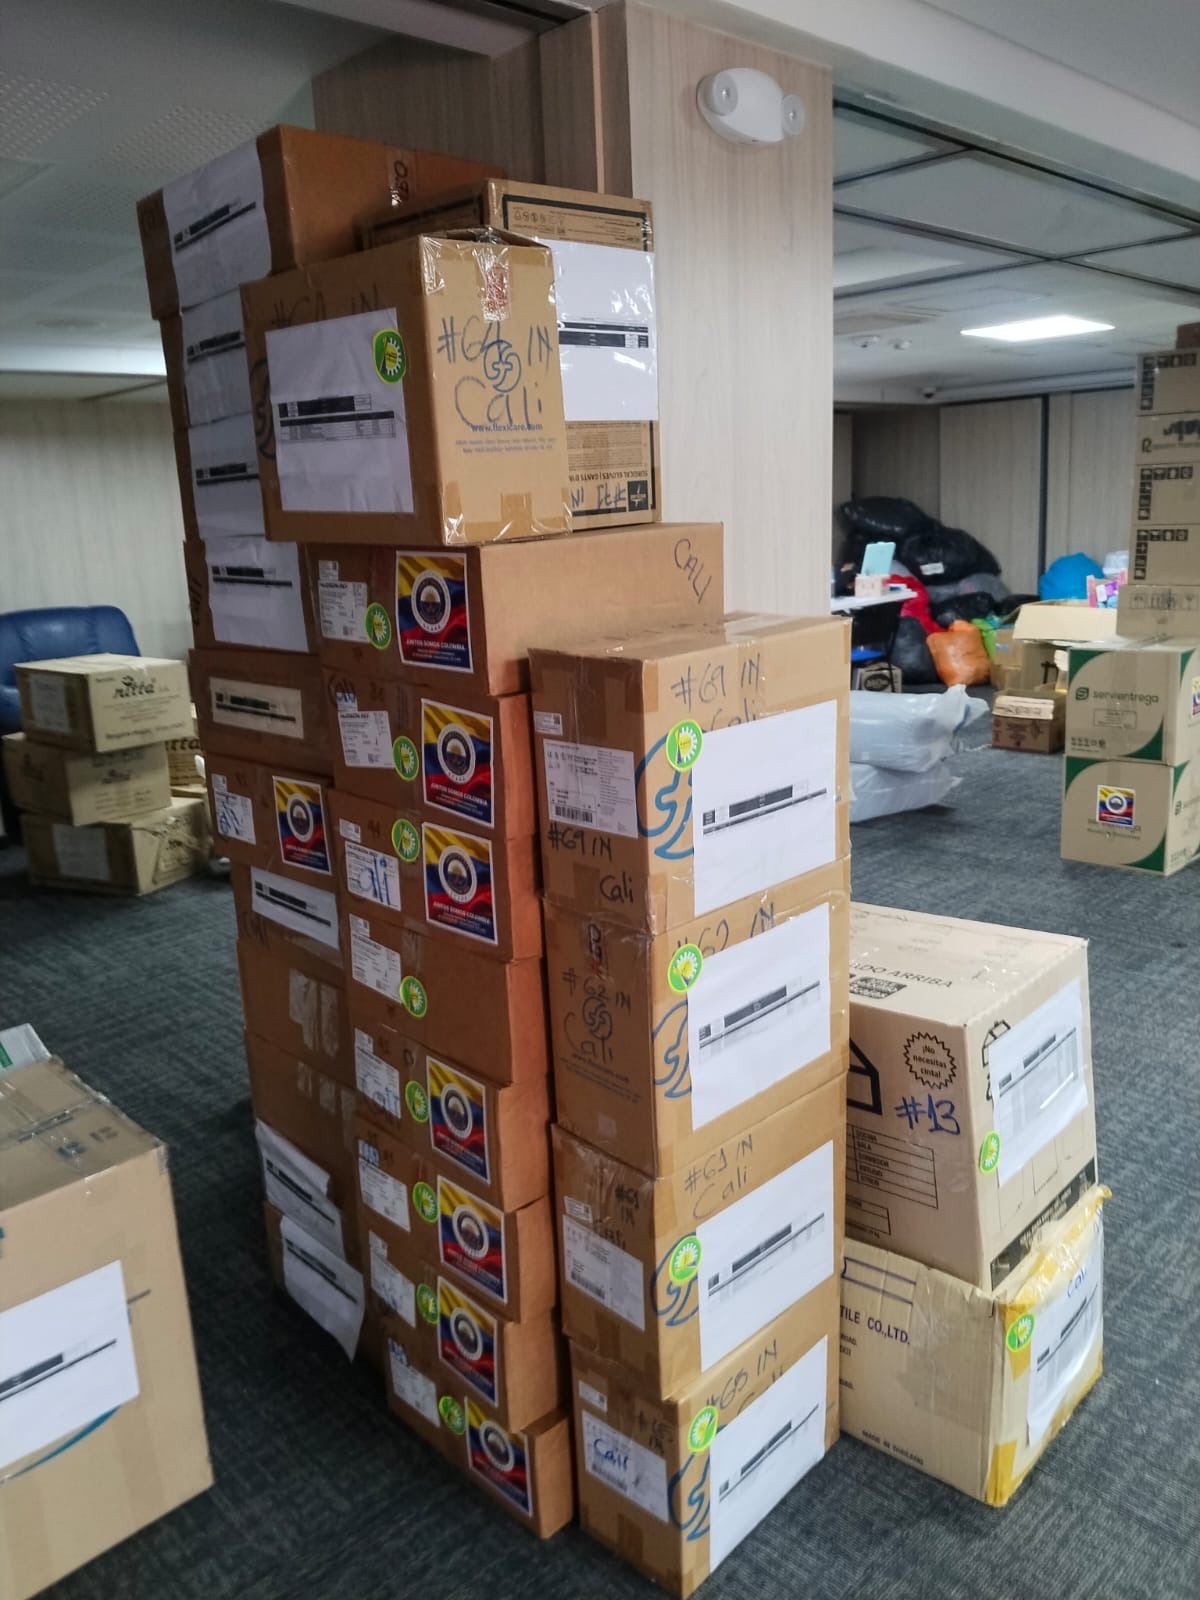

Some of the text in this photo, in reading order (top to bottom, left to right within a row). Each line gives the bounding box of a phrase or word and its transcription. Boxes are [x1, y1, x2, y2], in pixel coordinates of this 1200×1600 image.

[437, 315, 502, 363] #64
[528, 324, 553, 374] IN
[455, 375, 543, 431] Cali
[671, 653, 761, 713] #69 IN
[548, 822, 613, 863] #69 IN
[599, 872, 634, 905] Cali
[912, 1054, 947, 1069] necesitas
[894, 1093, 961, 1136] #13
[684, 1133, 753, 1195] #61 IN
[693, 1165, 748, 1220] Cali
[867, 1317, 910, 1345] CO.,LTD.
